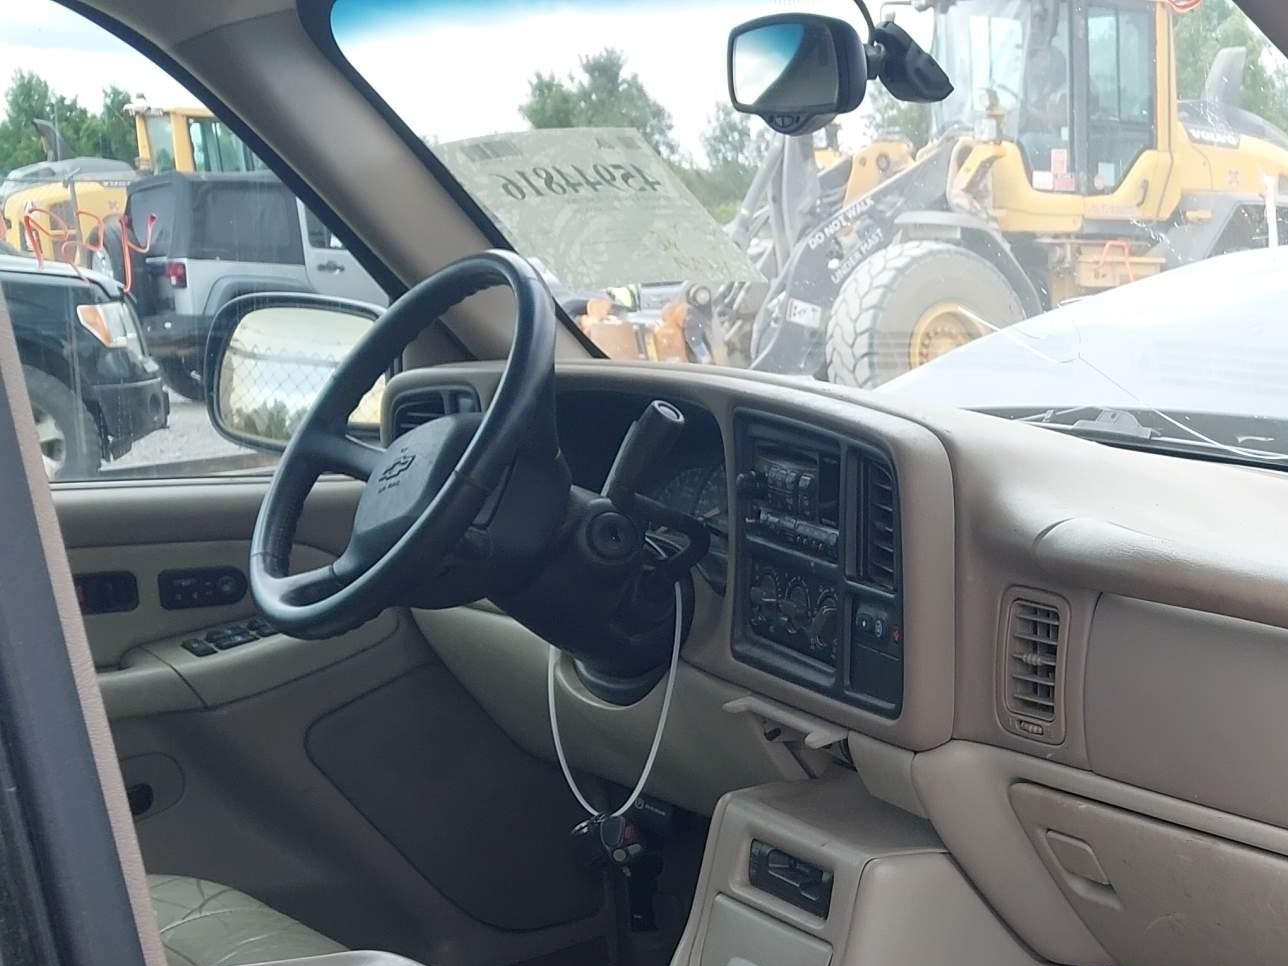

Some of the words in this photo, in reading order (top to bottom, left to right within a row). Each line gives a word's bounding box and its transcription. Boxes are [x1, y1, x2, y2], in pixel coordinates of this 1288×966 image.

[1188, 128, 1238, 146] VOLVO
[808, 231, 825, 249] DO
[823, 216, 847, 237] NOT
[845, 198, 874, 218] WALK
